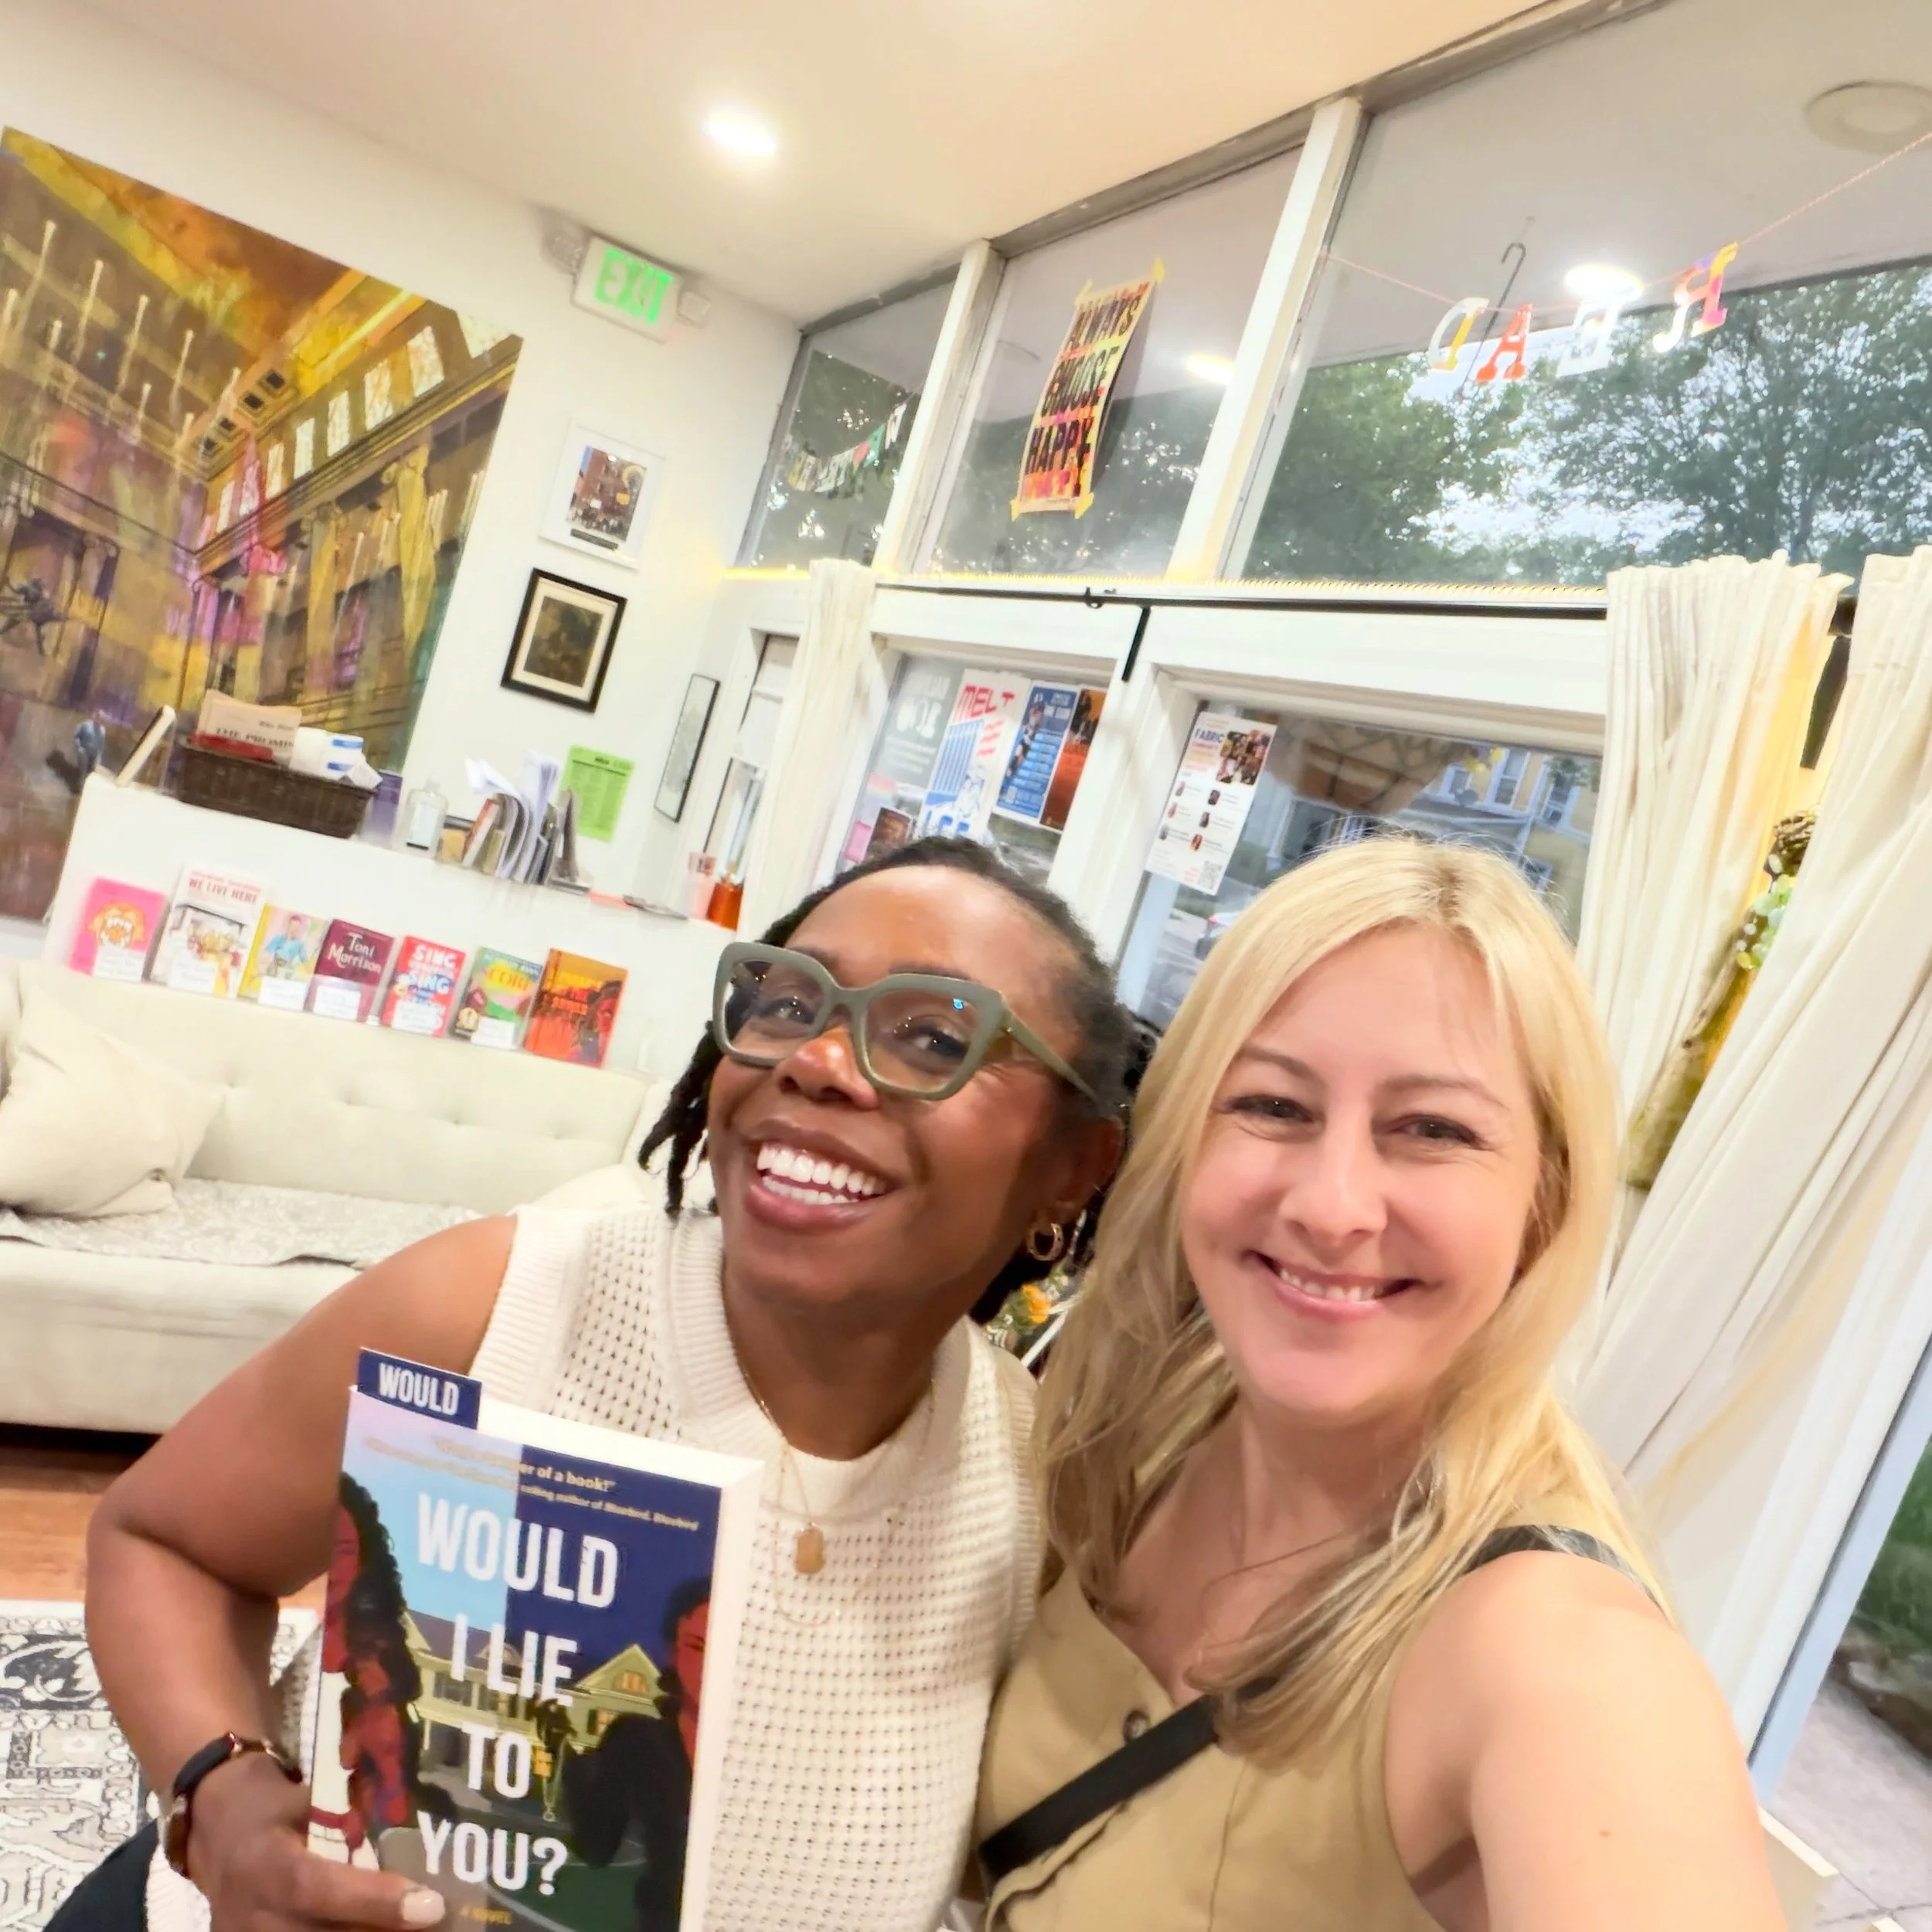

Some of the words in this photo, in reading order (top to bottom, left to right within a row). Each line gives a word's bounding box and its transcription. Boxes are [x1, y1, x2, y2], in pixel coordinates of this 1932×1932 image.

[594, 248, 675, 324] EXIT
[1024, 417, 1094, 497] HAPPY
[951, 684, 1017, 722] MELT
[1193, 727, 1225, 743] FABRIC
[189, 878, 203, 890] WE
[206, 882, 228, 896] LIVE
[231, 889, 258, 905] HERE
[328, 942, 383, 974] Morrison
[347, 931, 376, 957] Toni
[412, 944, 457, 968] SING
[377, 1362, 459, 1417] WOULD
[537, 1466, 552, 1481] of
[417, 1493, 618, 1608] WOULD
[451, 1613, 468, 1682] I
[487, 1623, 578, 1706] LIE
[462, 1721, 531, 1799] TO
[417, 1812, 568, 1896] YOU?
